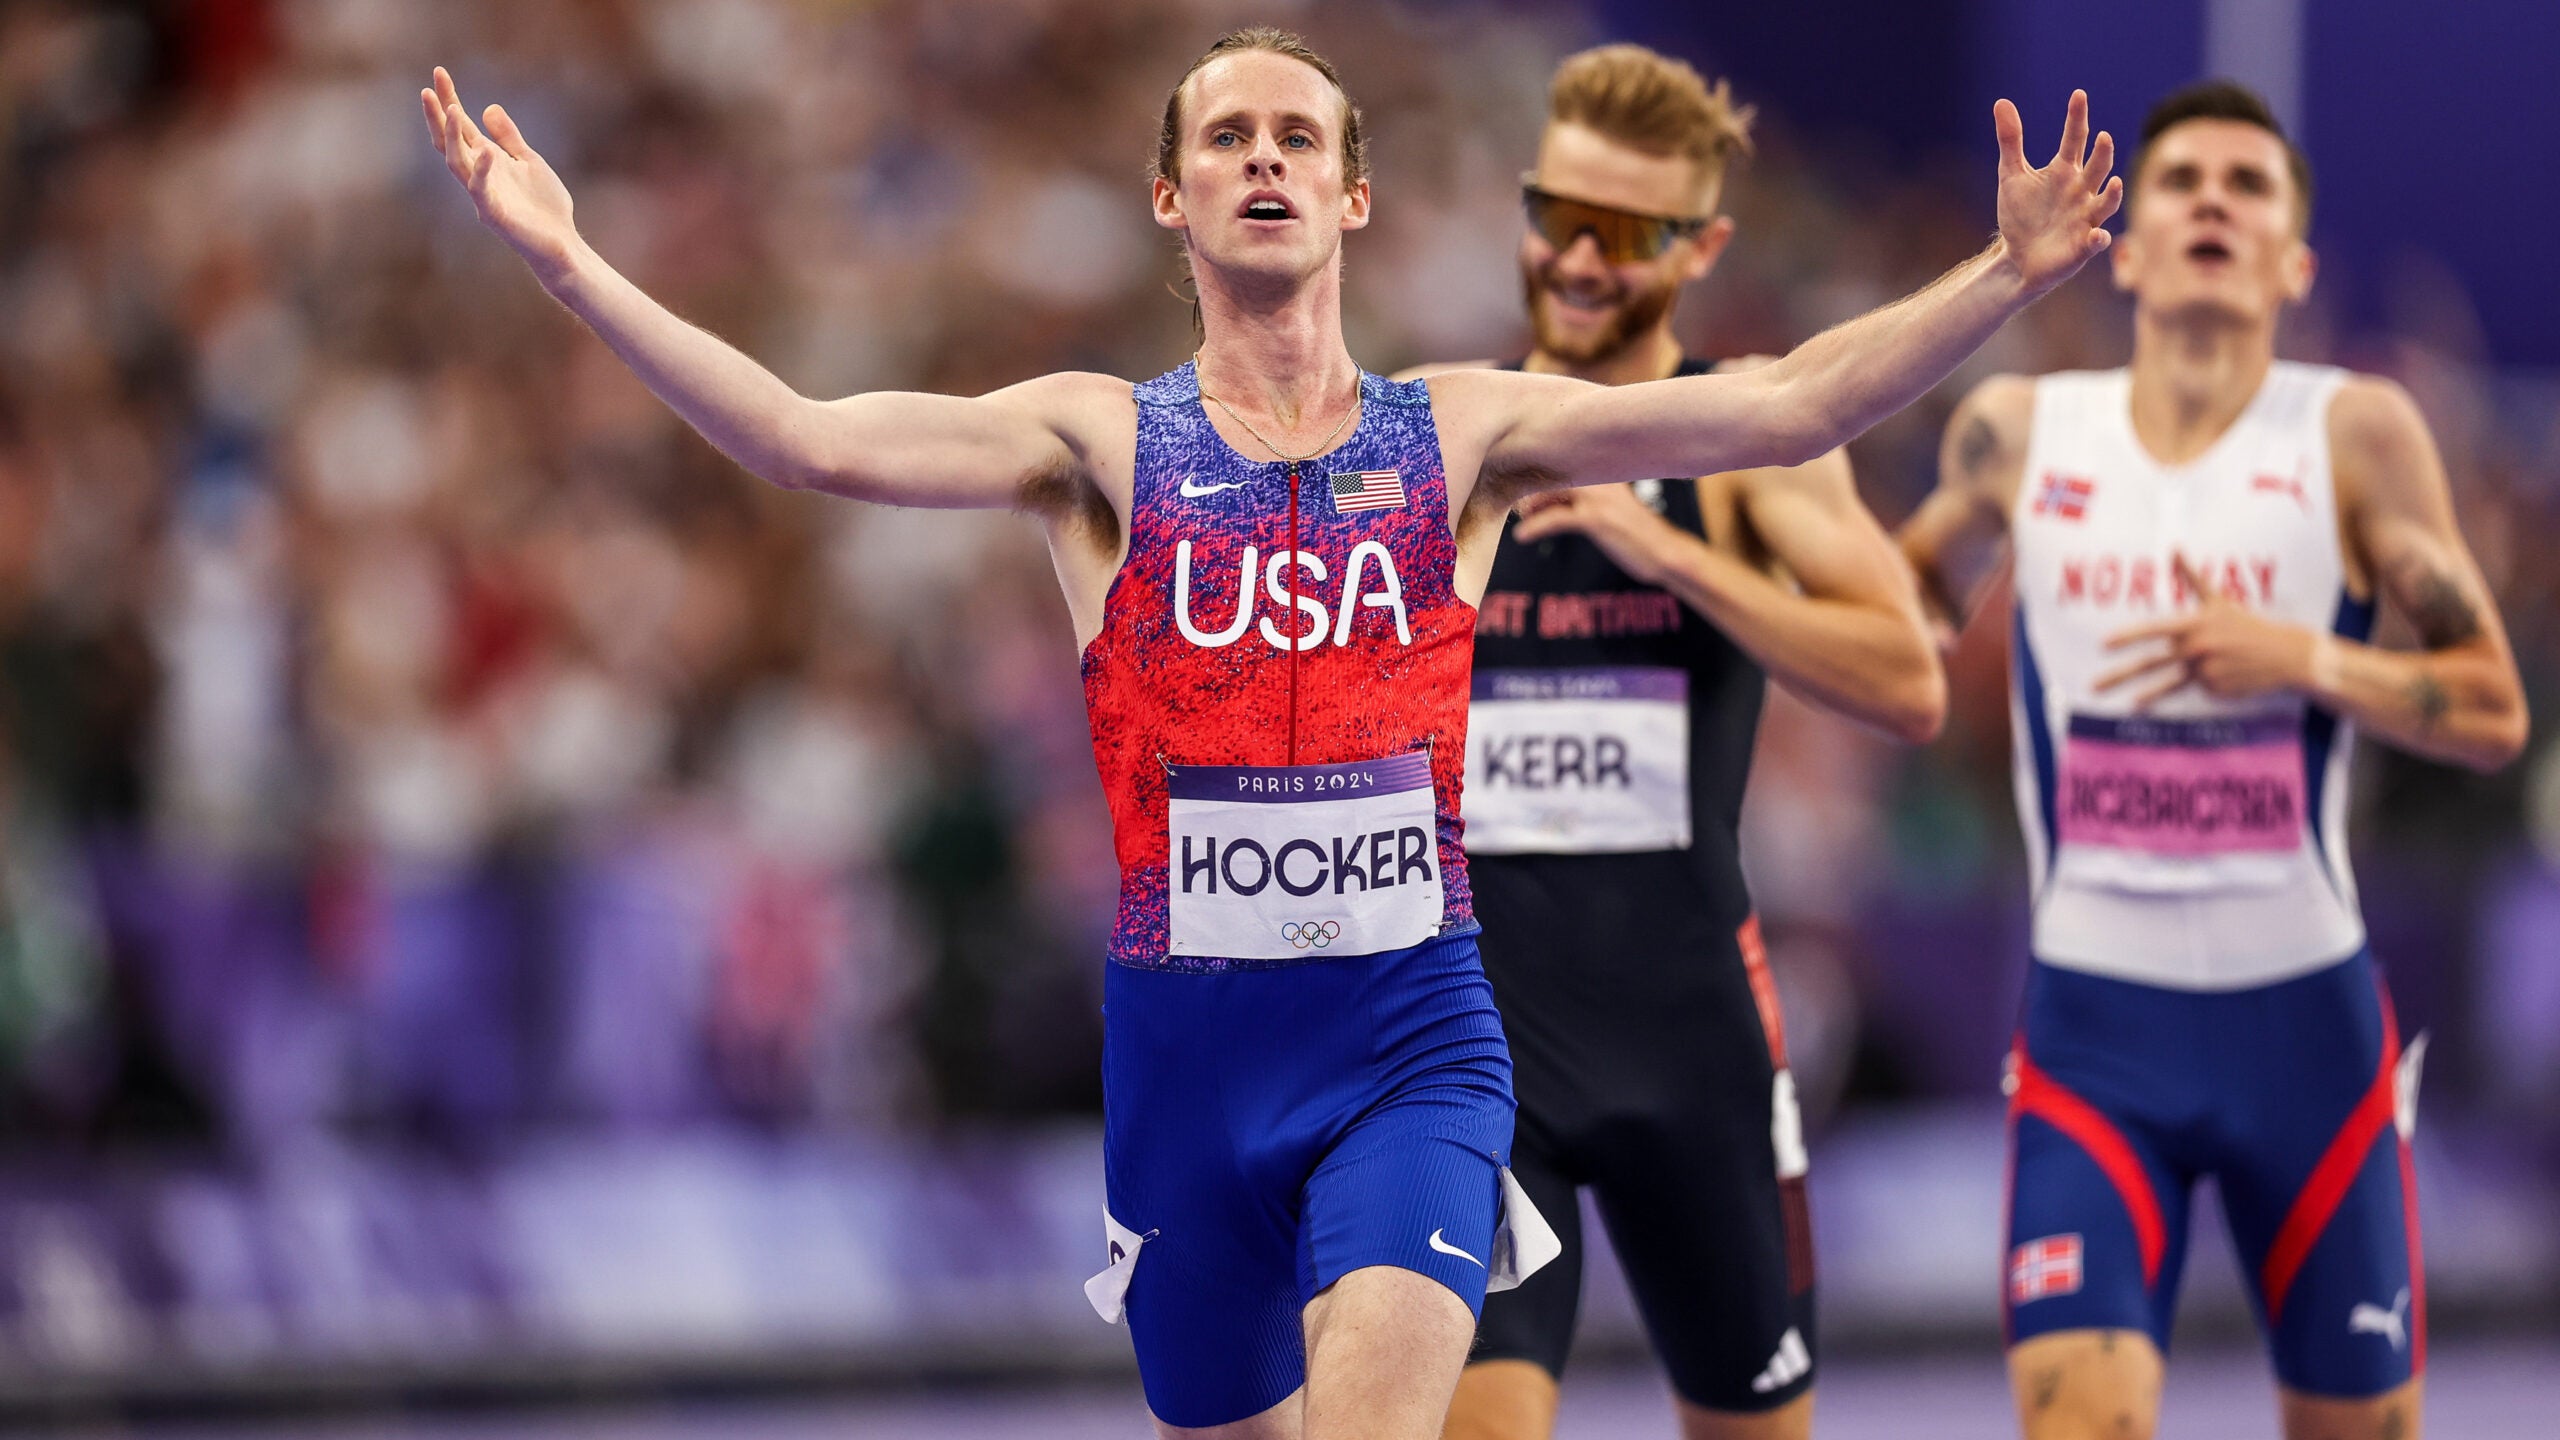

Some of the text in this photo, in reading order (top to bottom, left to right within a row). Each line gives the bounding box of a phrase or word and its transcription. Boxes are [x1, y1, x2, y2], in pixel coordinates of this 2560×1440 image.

[1173, 539, 1412, 651] USA
[1314, 772, 1374, 791] 2024
[1481, 734, 1632, 790] KERR
[1182, 826, 1433, 898] HOCKER
